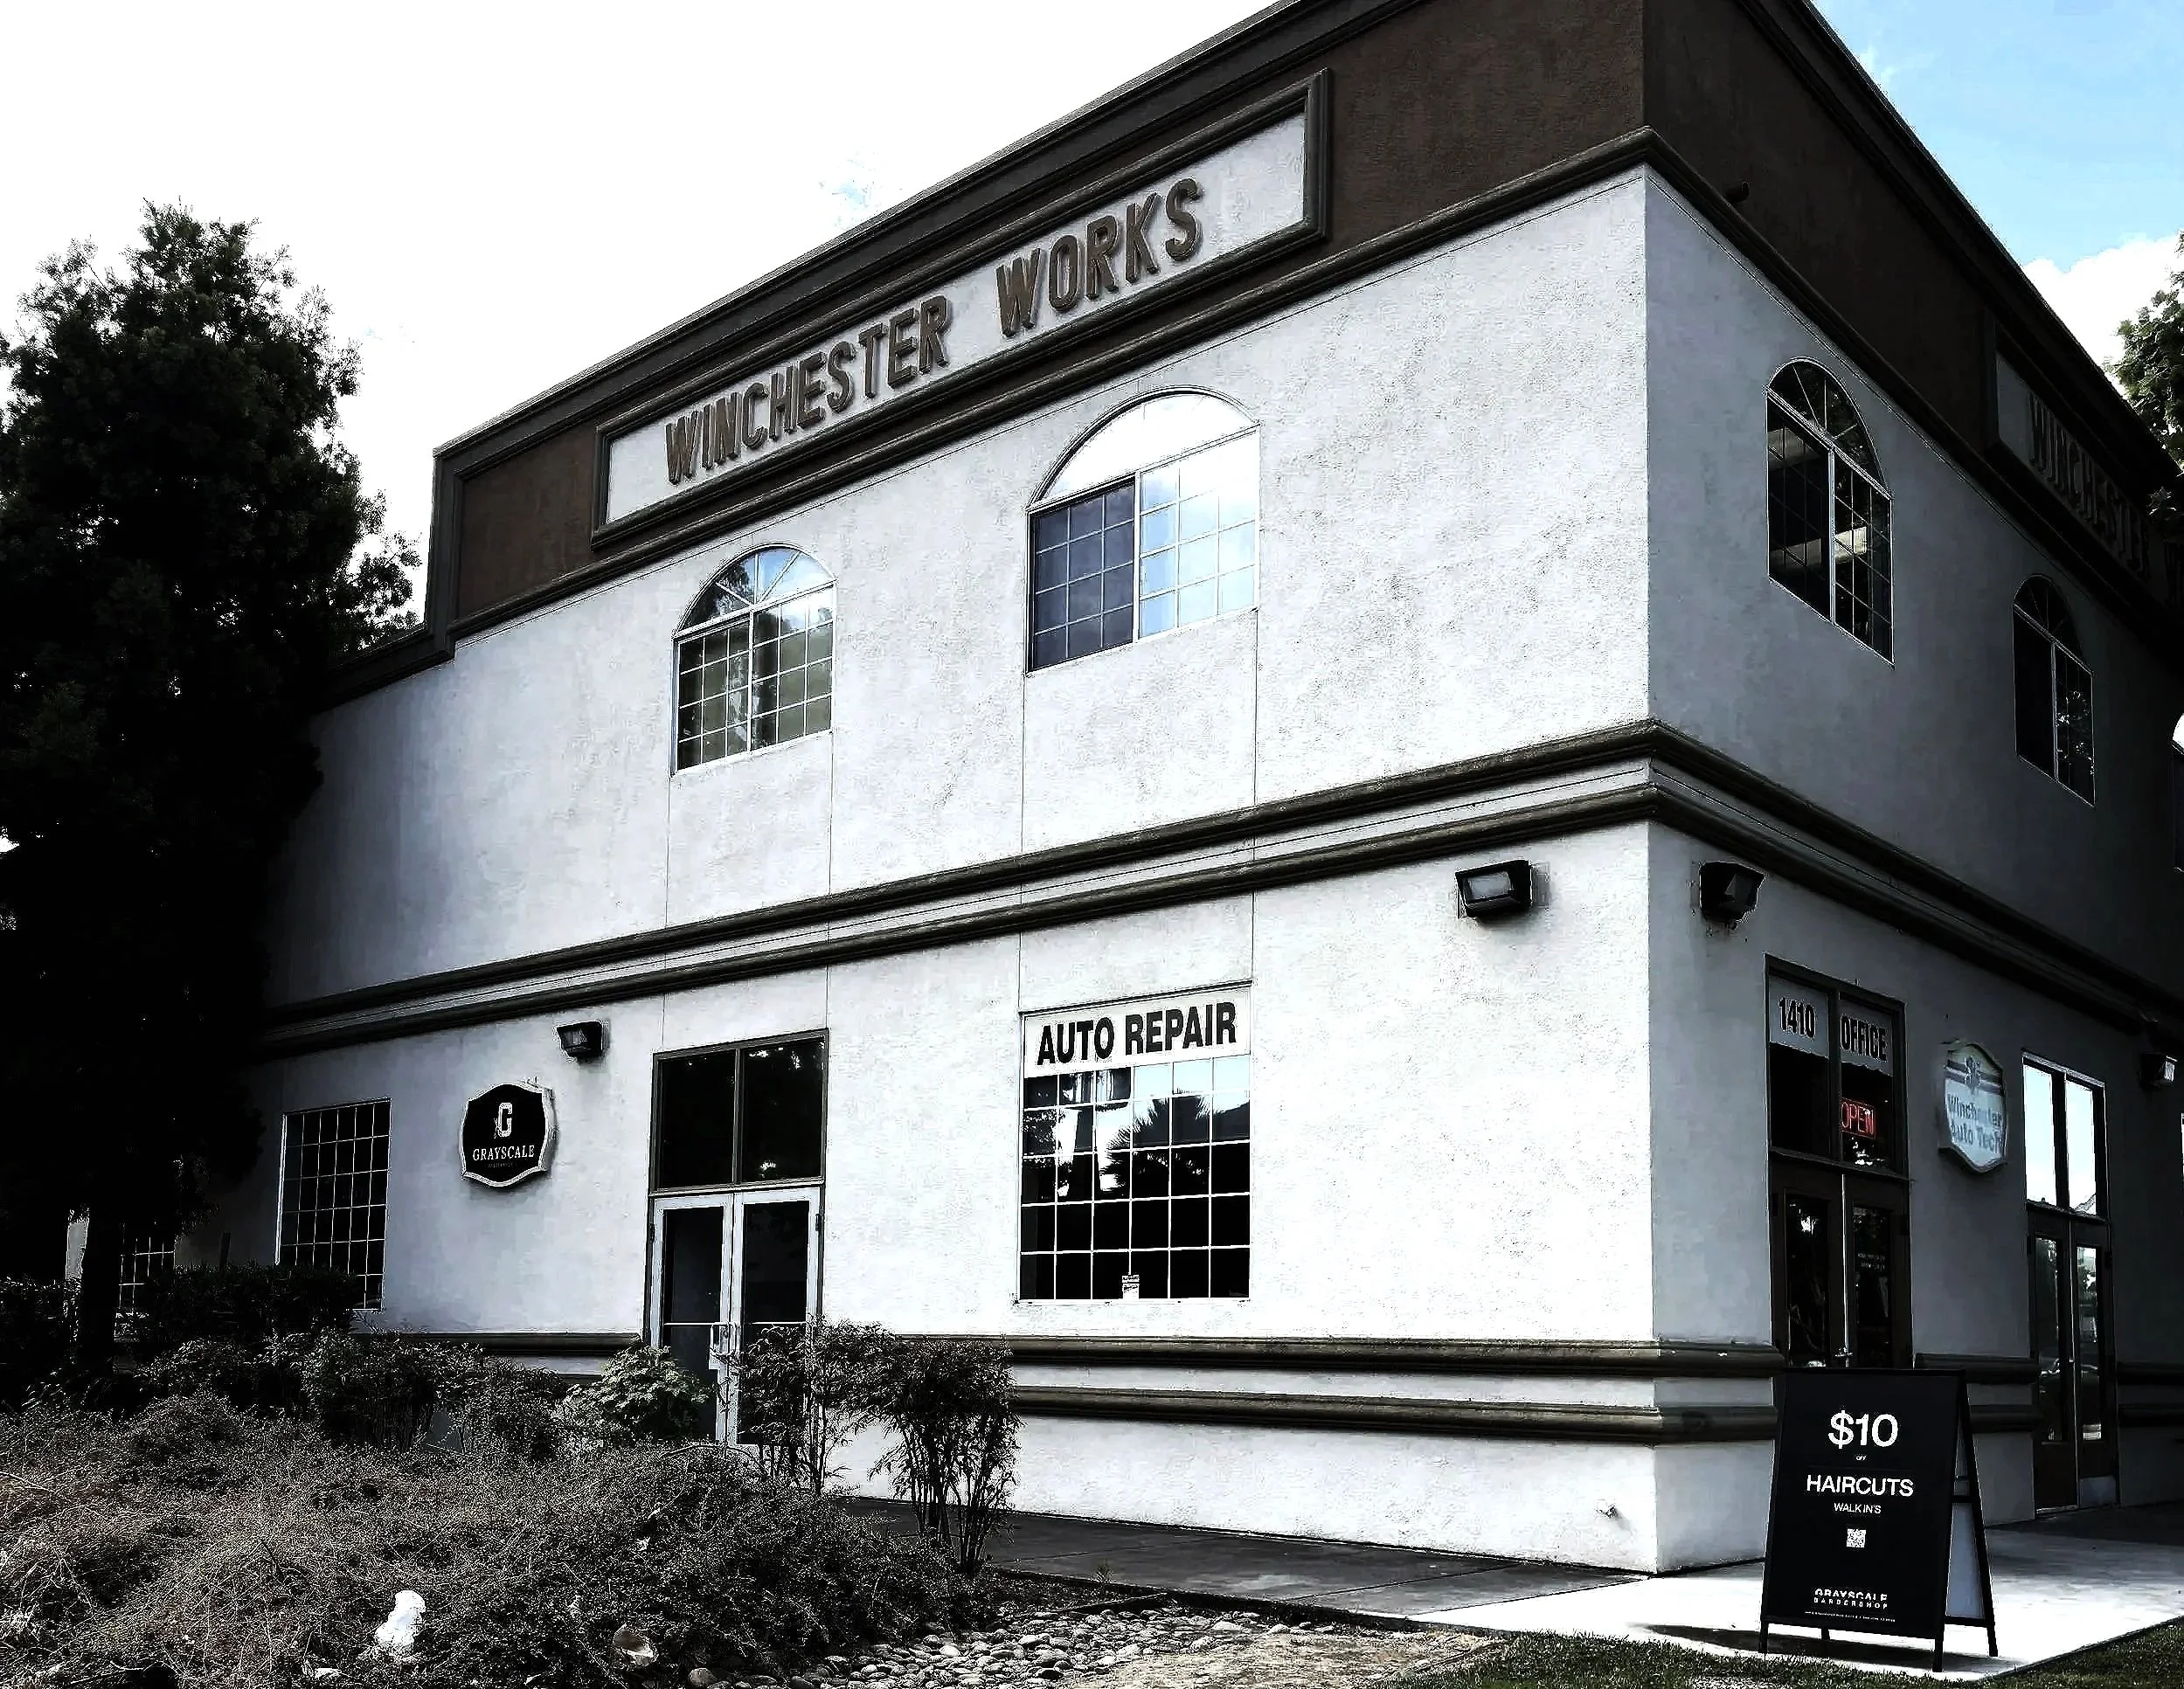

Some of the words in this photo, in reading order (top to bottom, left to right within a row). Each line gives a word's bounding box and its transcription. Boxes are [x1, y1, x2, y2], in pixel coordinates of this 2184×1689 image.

[665, 295, 950, 485] WINCHESTER
[996, 178, 1203, 337] WORKS
[1037, 1017, 1115, 1065] AUTO
[1126, 1001, 1237, 1056] REPAIR
[1778, 996, 1816, 1039] 1410
[1840, 1015, 1888, 1063] OFFICE
[1841, 1101, 1875, 1135] OPEN
[473, 1145, 535, 1161] GRAYSCALE
[1827, 1409, 1898, 1450] $10
[1806, 1474, 1914, 1497] HAIRCUTS
